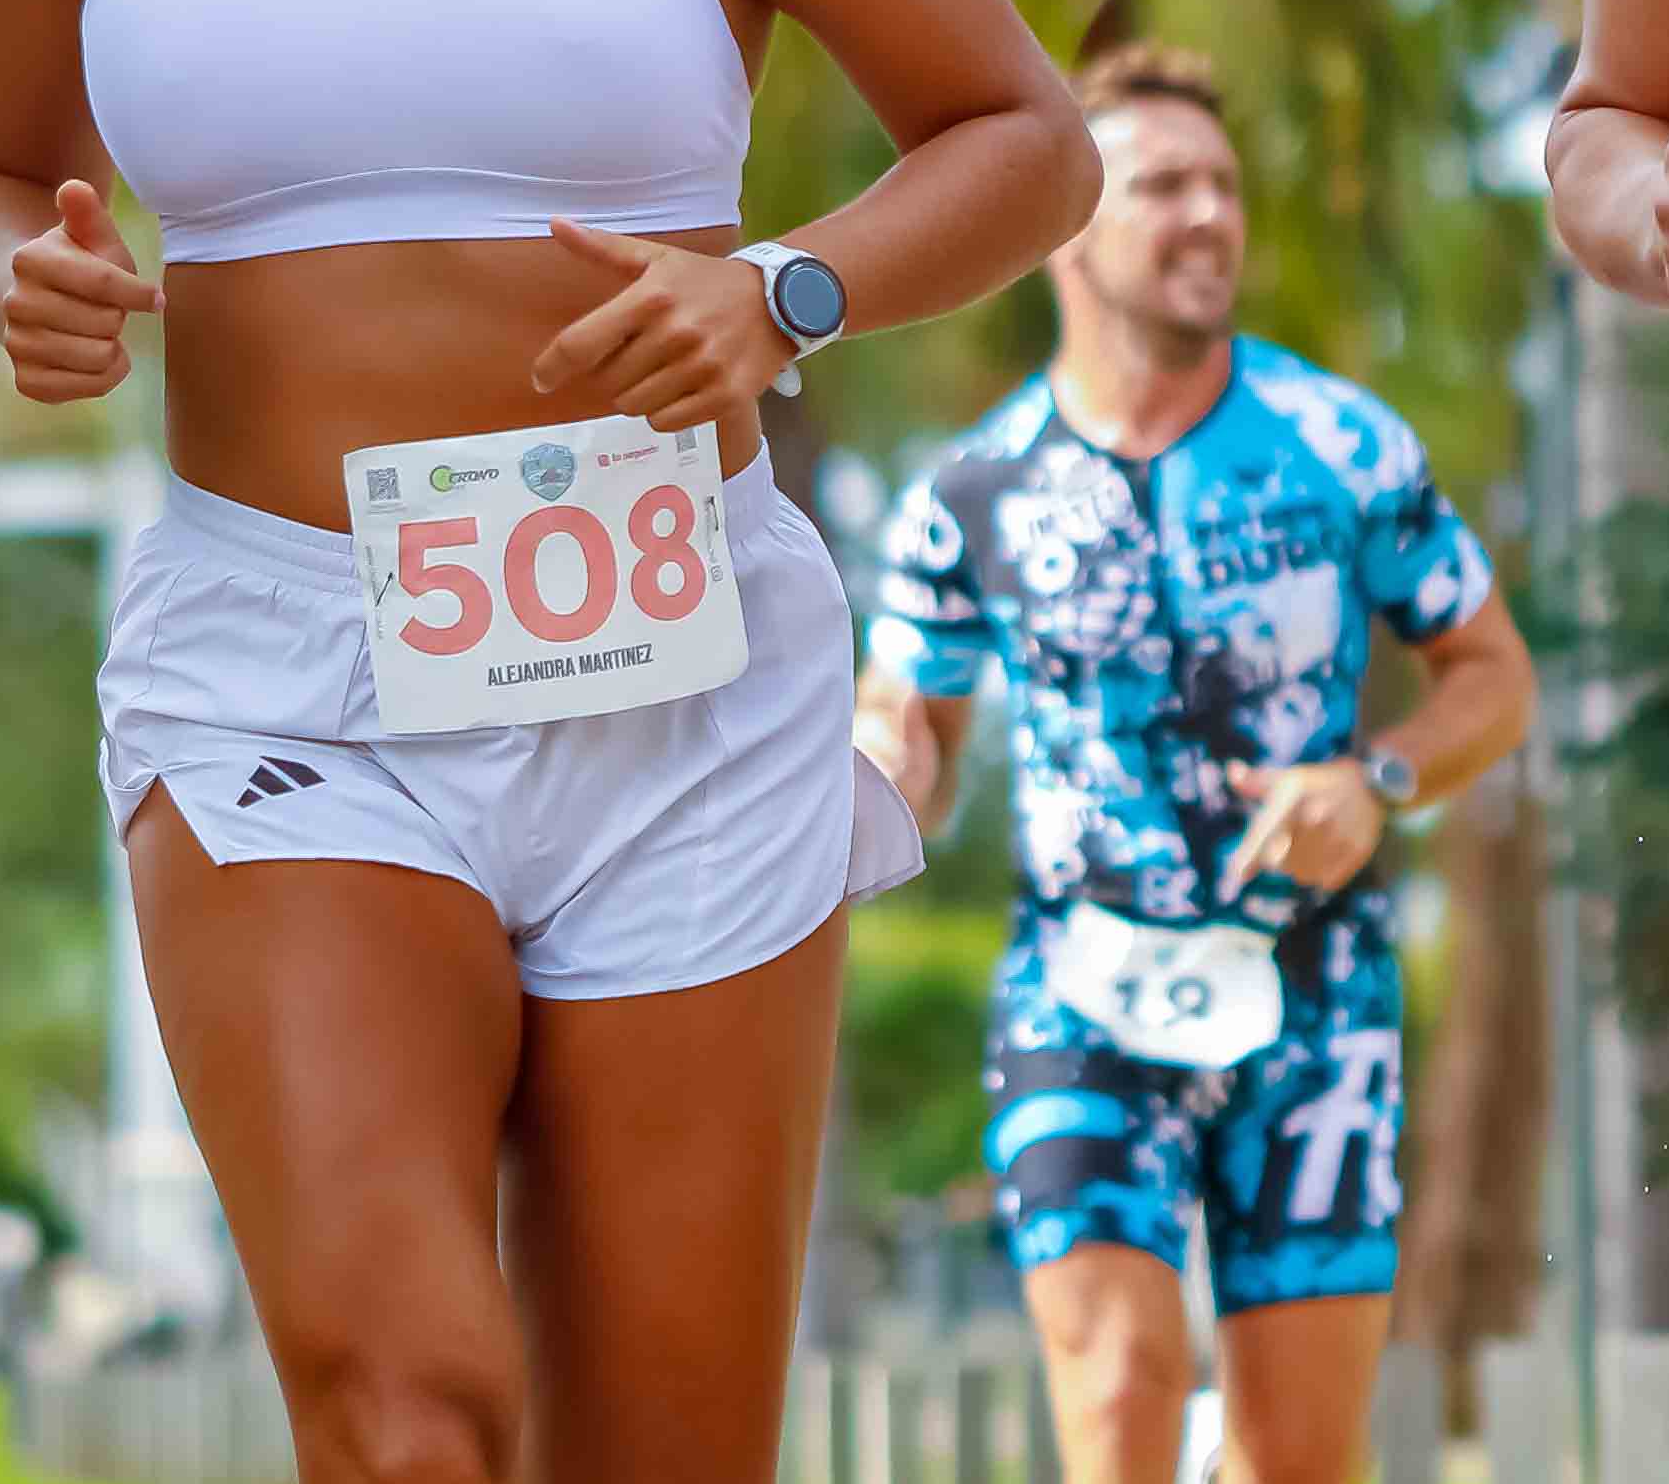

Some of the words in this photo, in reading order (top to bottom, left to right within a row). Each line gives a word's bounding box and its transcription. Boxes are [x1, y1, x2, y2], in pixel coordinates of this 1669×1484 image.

[398, 484, 707, 656] 508
[487, 657, 576, 686] ALEJANDRA
[579, 643, 654, 674] MARTINEZ
